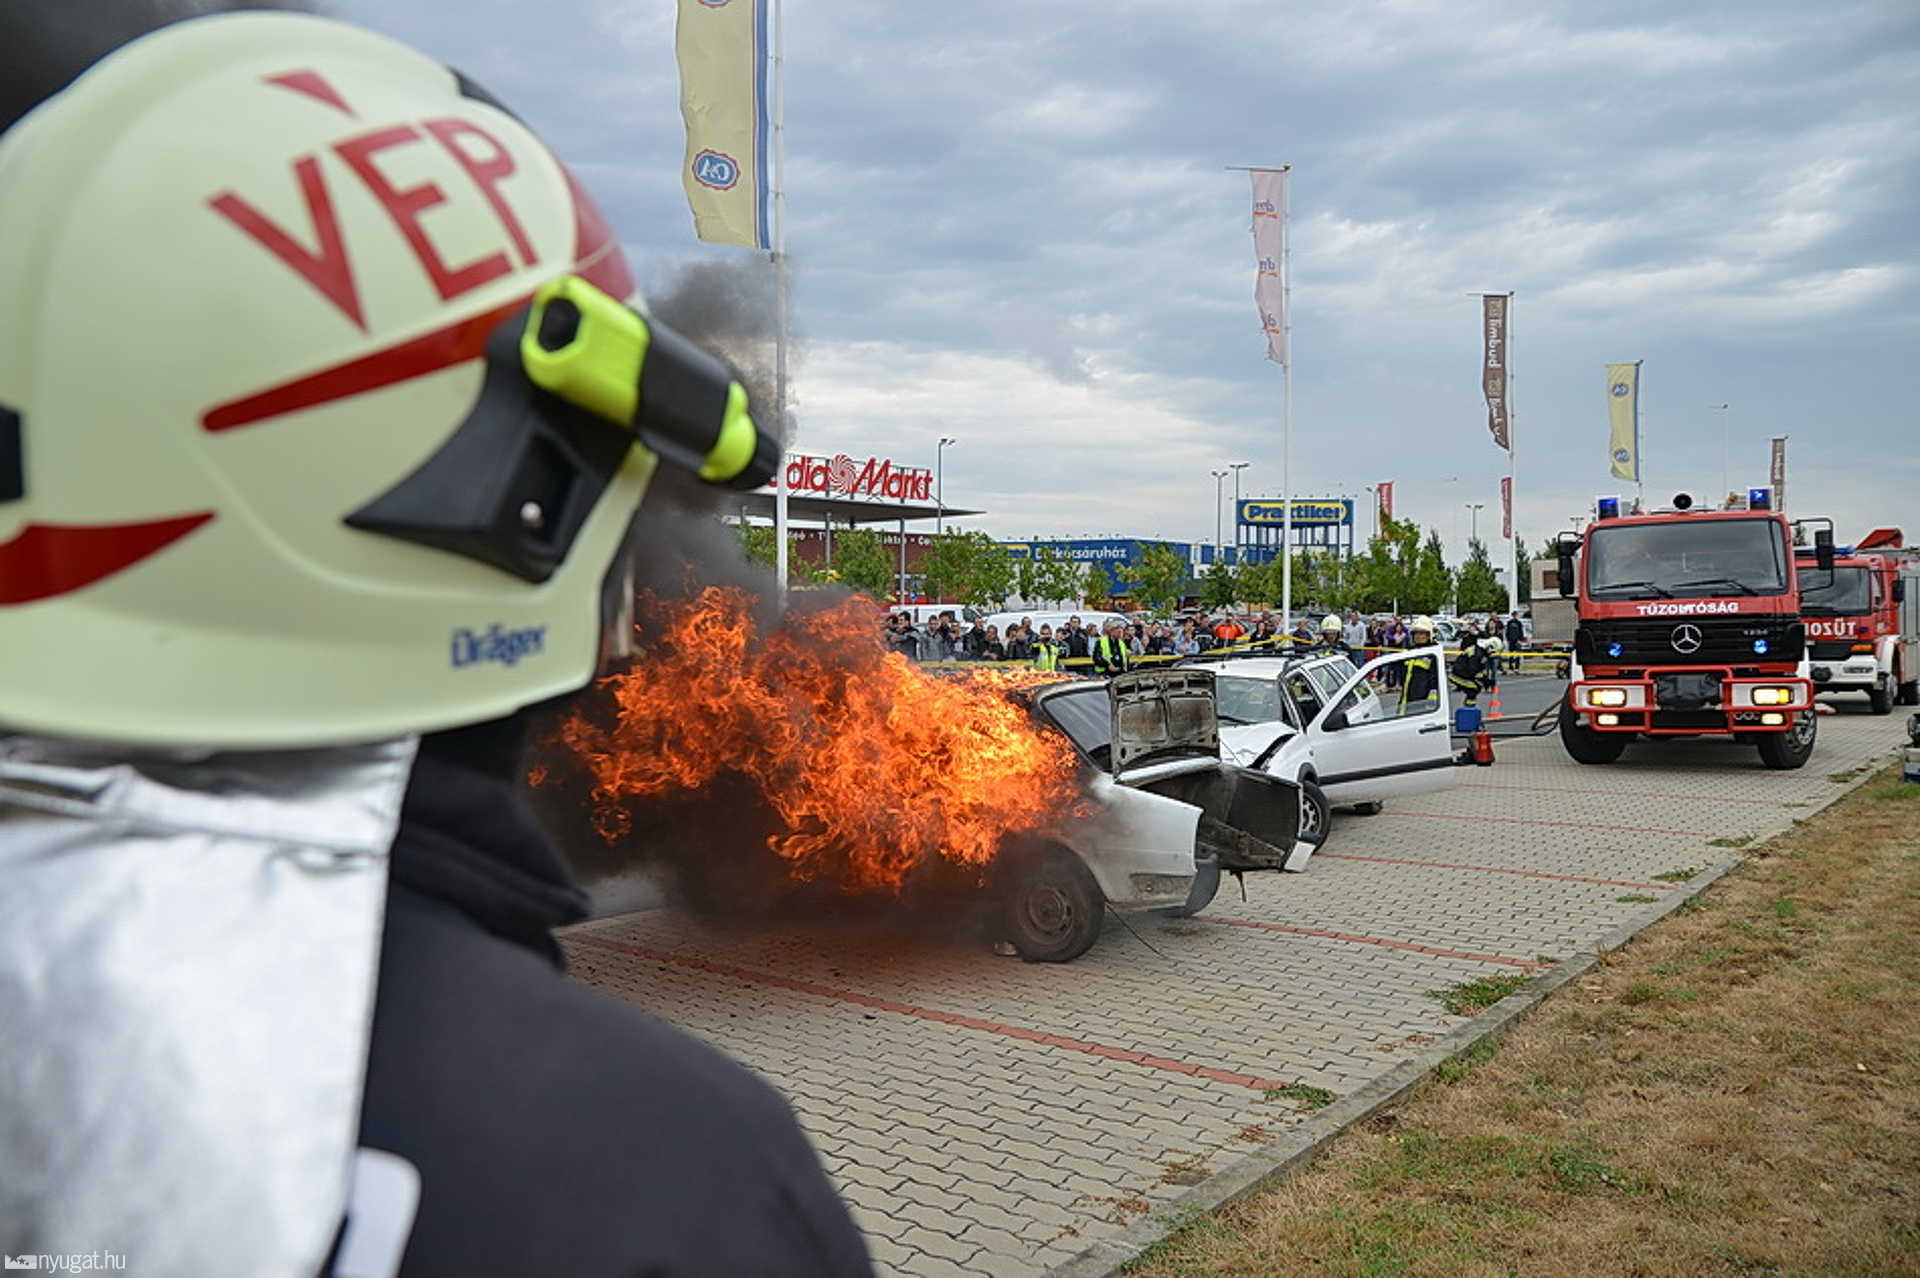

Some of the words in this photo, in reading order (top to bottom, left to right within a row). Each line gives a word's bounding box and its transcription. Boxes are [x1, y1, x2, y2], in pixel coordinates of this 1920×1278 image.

[206, 118, 541, 336] VEP
[768, 456, 830, 492] dia
[847, 457, 933, 500] Markt
